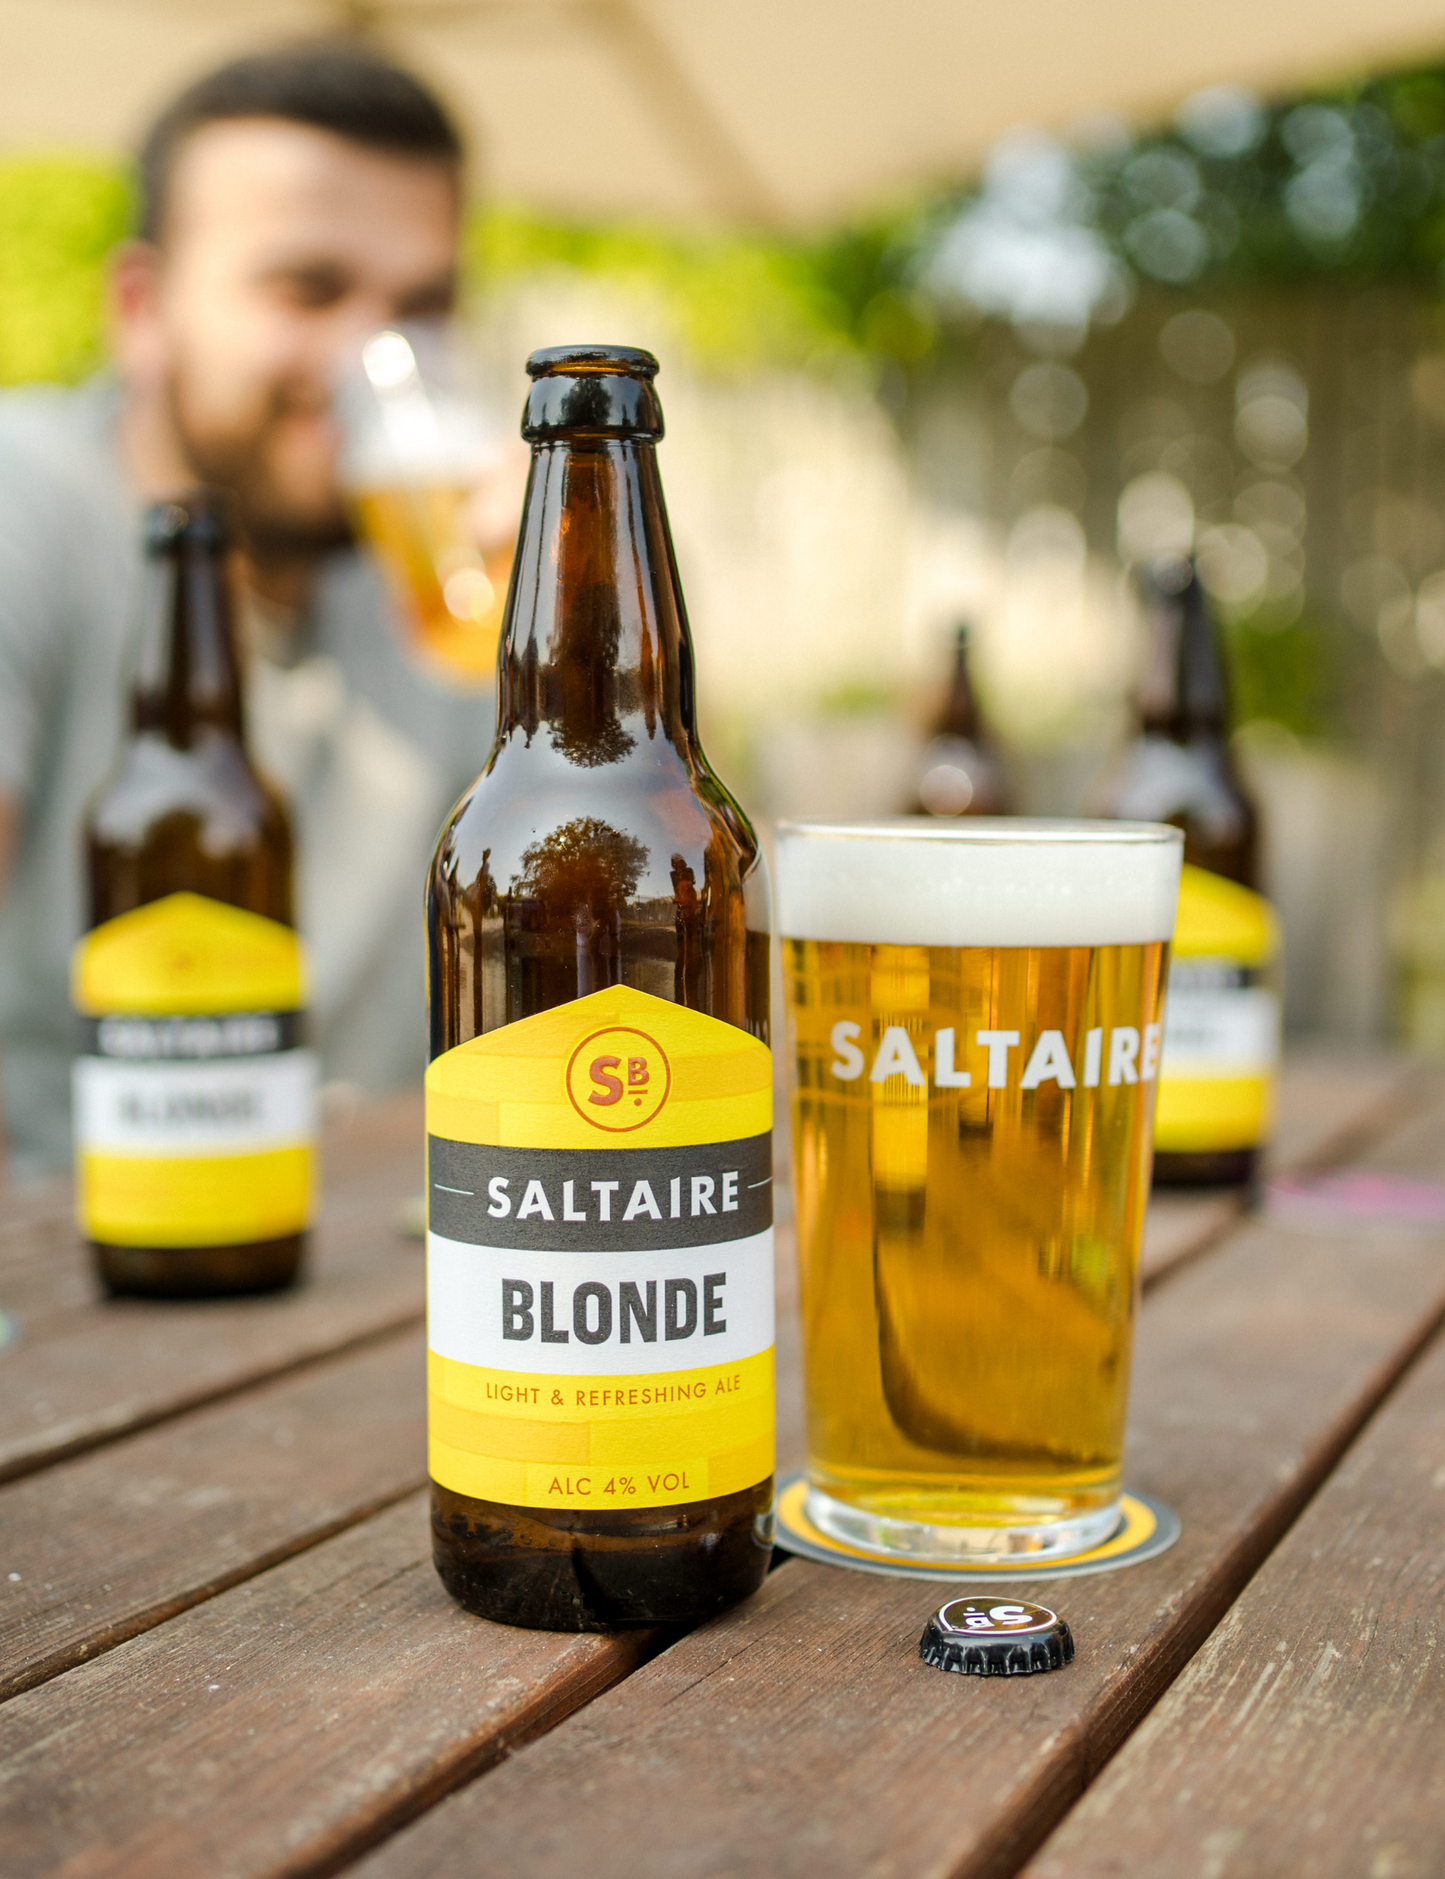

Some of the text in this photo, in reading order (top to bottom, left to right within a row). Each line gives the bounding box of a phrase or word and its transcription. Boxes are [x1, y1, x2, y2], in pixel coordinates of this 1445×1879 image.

[830, 1020, 1160, 1090] SALTAIRE
[487, 1170, 740, 1222] SALTAIRE
[501, 1272, 727, 1345] BLONDE
[485, 1374, 741, 1407] LIGHT & REFRESHING ALE
[548, 1471, 690, 1496] ALC 4% VOL
